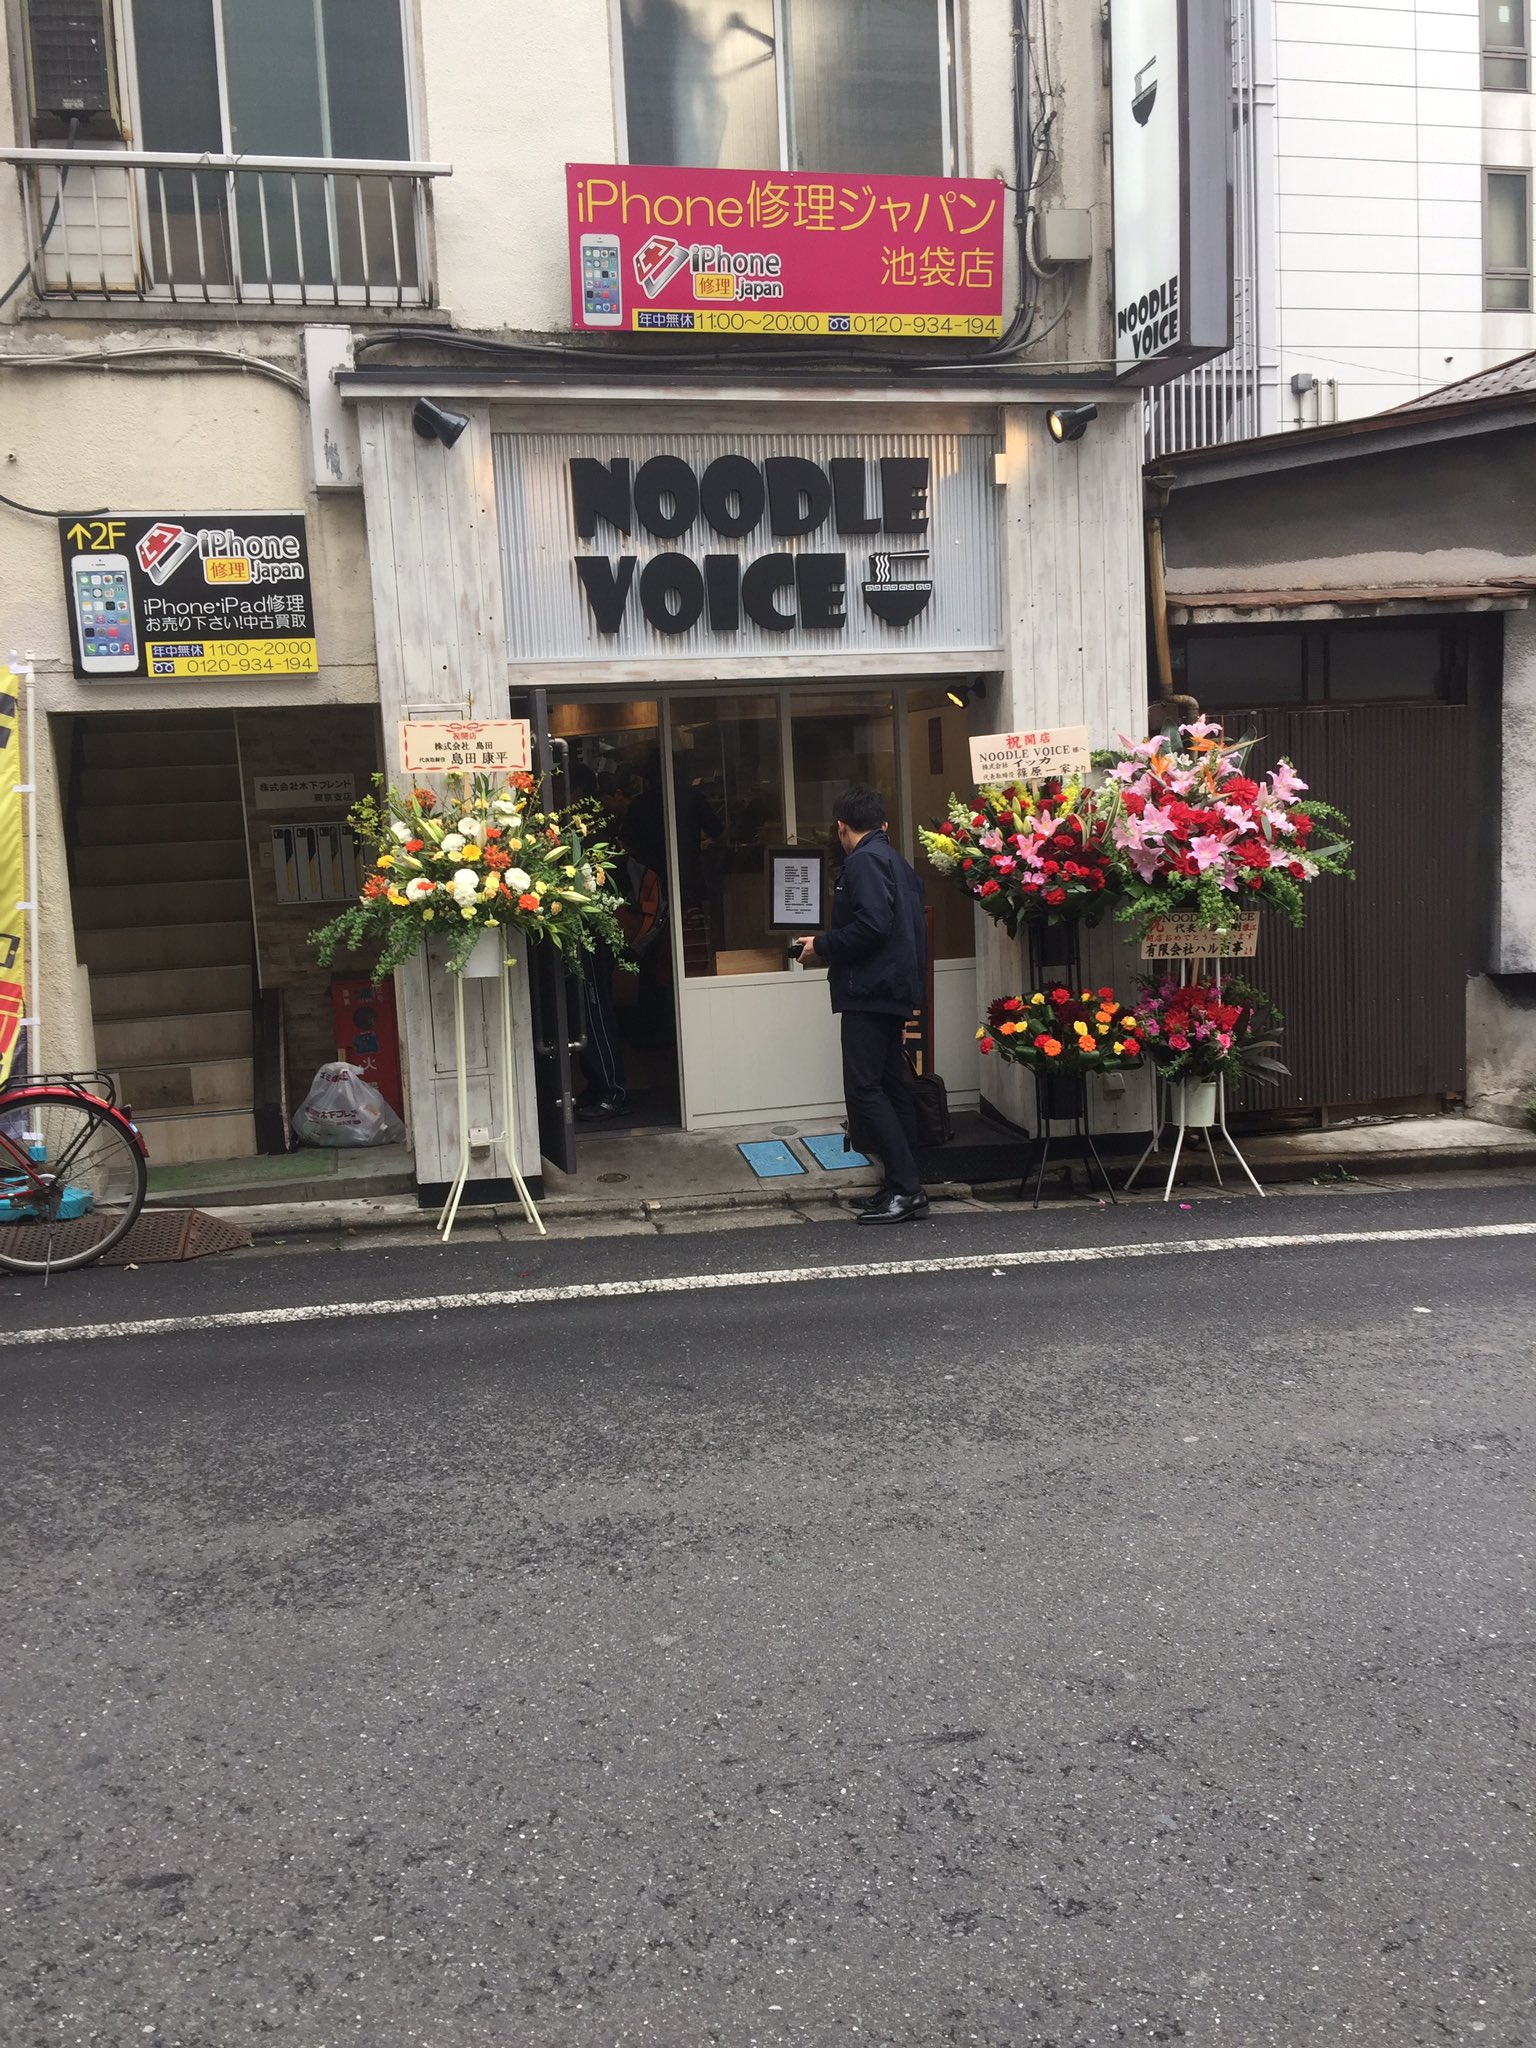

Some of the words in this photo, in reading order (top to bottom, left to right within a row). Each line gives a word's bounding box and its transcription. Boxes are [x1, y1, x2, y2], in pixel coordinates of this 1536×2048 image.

[577, 178, 996, 235] iPhone修理ジャパン
[691, 244, 782, 275] iPhone
[881, 245, 995, 288] 池袋店
[699, 277, 731, 296] 修理
[1117, 274, 1178, 339] NOODLE
[638, 312, 694, 328] 年中無休
[1131, 308, 1178, 359] VOICE
[569, 454, 931, 539] NOODLE
[90, 521, 127, 550] 2F
[199, 529, 300, 560] iPhone
[210, 561, 246, 579] 修理
[574, 551, 848, 634] VOICE
[152, 645, 204, 658] 年中無休
[187, 658, 313, 673] 0120-934-194
[434, 742, 470, 751] 株式会社
[475, 741, 494, 751] 島田
[1005, 732, 1052, 749] 祝開店
[451, 752, 477, 765] 島田
[481, 751, 509, 765] 康平
[979, 749, 1030, 762] NOODLE
[1033, 744, 1071, 757] VOICE
